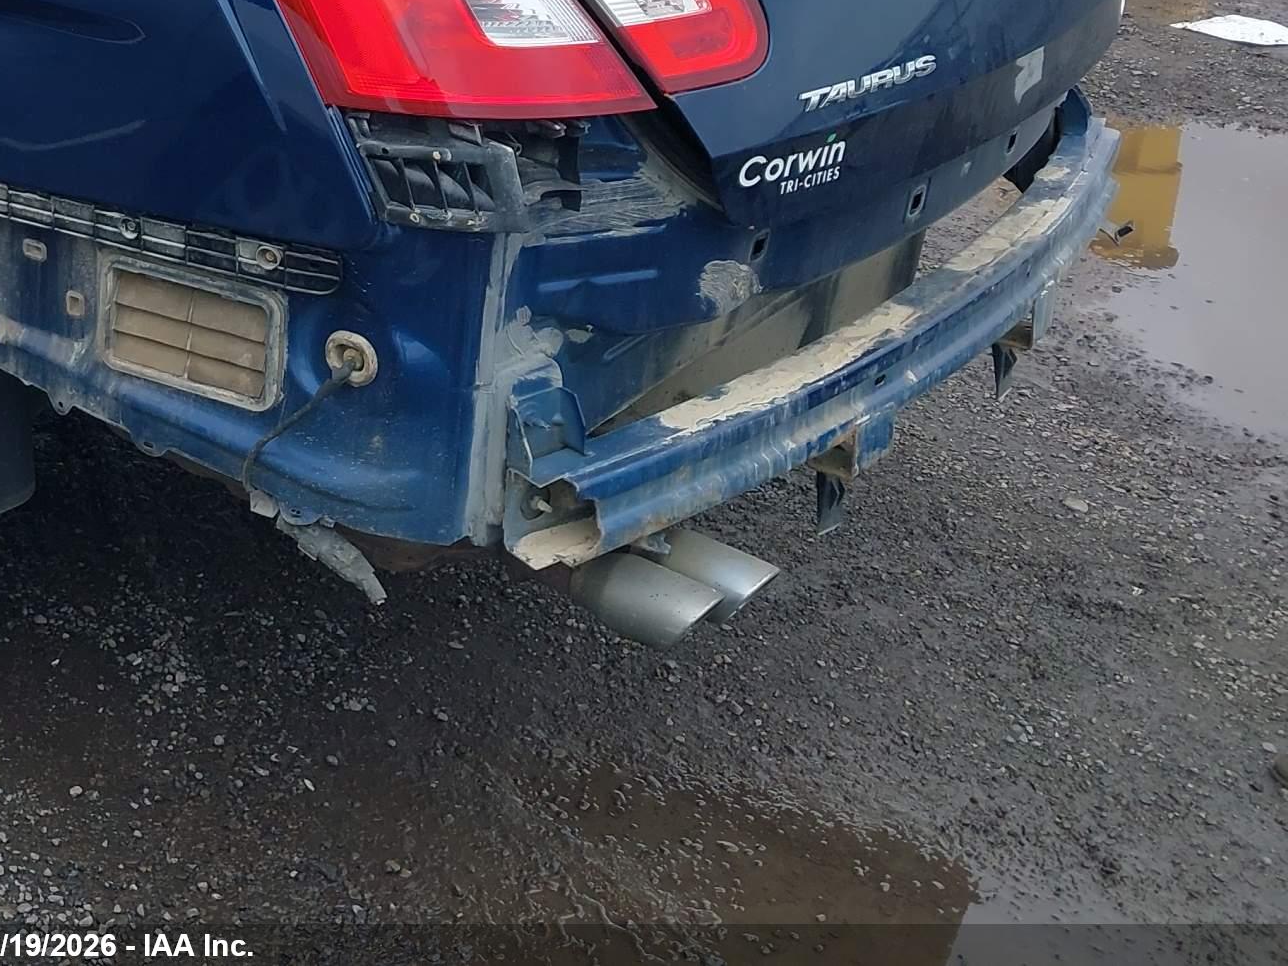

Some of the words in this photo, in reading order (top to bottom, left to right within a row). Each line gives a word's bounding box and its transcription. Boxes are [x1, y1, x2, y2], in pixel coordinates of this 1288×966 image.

[799, 54, 937, 112] TAURUS
[739, 133, 847, 188] Corwin
[779, 166, 841, 195] TRI-CITIES
